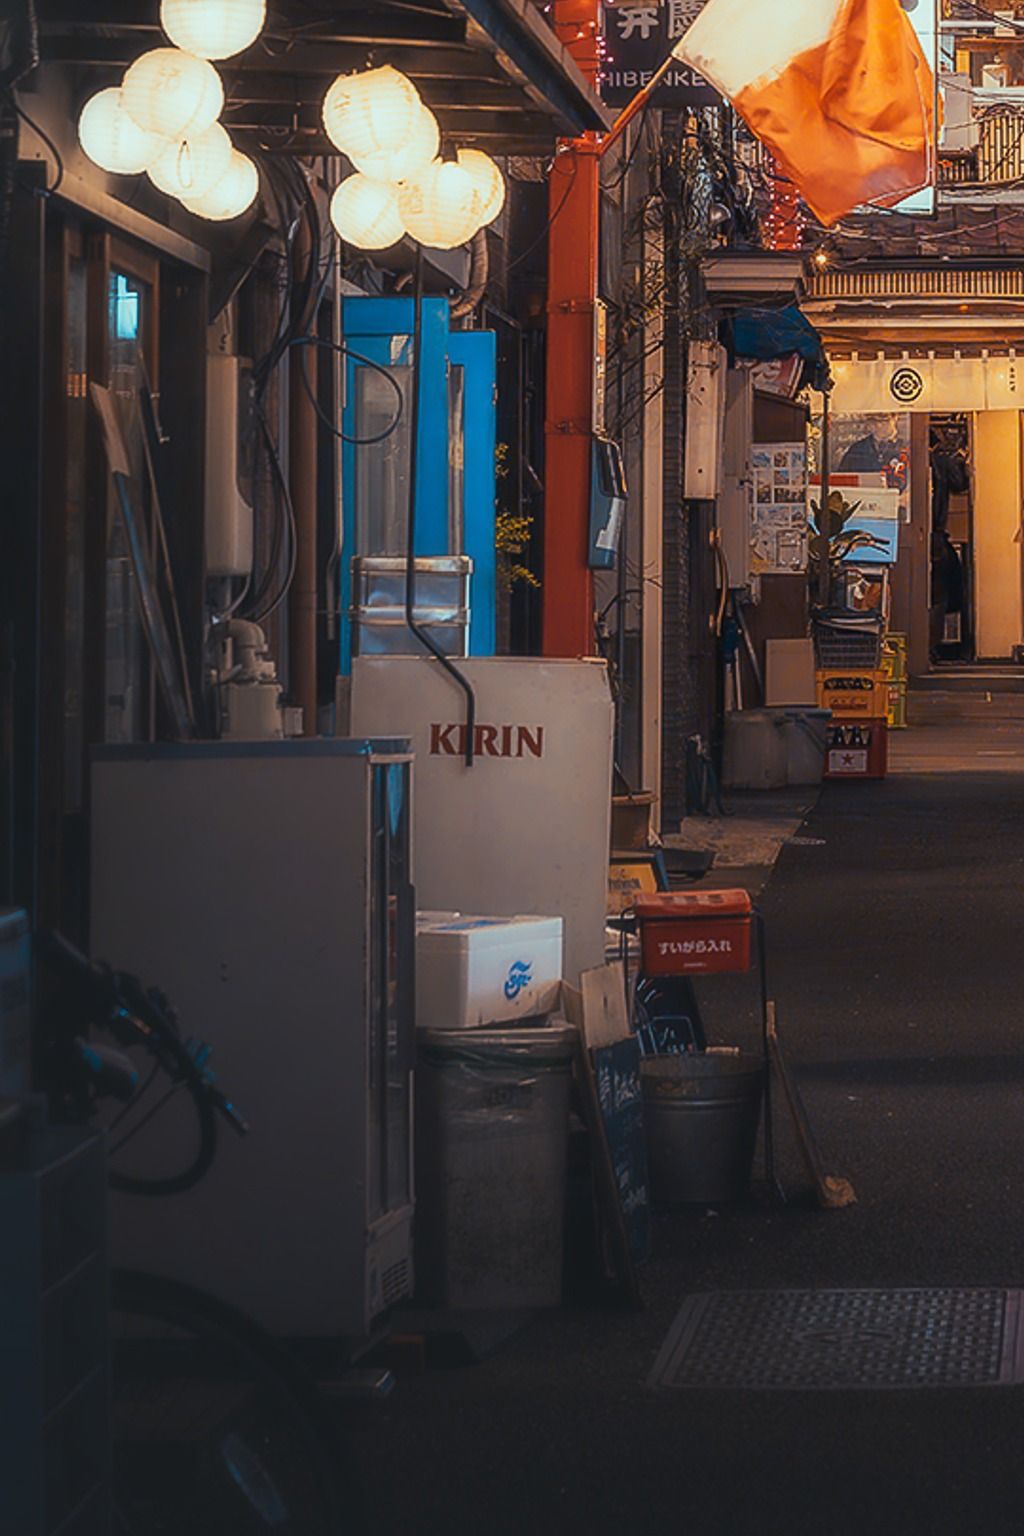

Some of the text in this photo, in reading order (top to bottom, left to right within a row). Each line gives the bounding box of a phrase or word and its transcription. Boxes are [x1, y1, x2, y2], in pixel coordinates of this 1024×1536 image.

[429, 723, 544, 758] KIRIN
[657, 939, 732, 955] すいがら入れ
